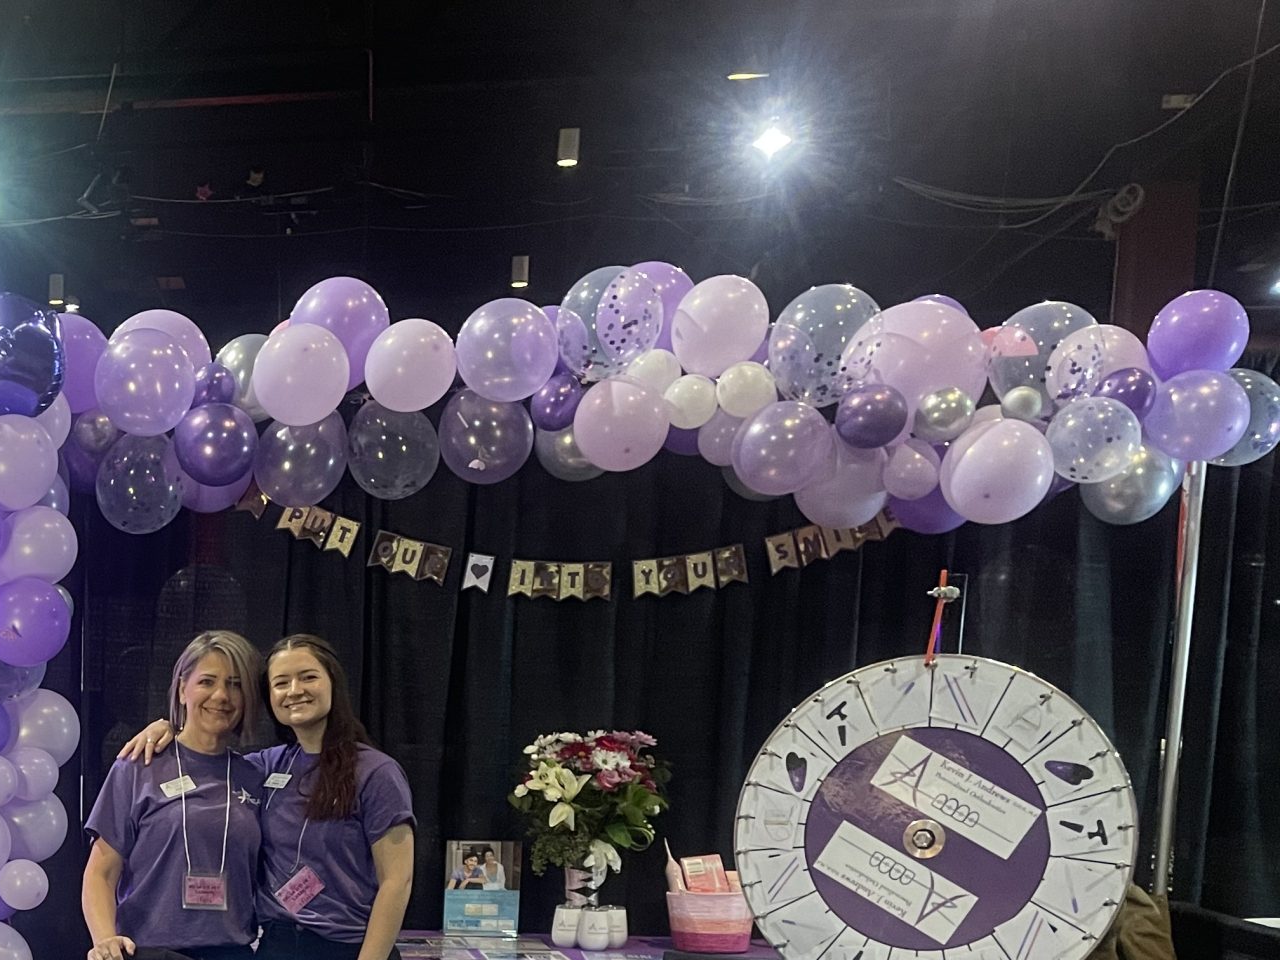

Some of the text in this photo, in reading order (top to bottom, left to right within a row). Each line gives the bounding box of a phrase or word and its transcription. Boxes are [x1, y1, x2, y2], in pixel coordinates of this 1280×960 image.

[287, 508, 352, 544] PUT
[939, 759, 964, 779] Kevin
[974, 778, 1011, 804] Andrews
